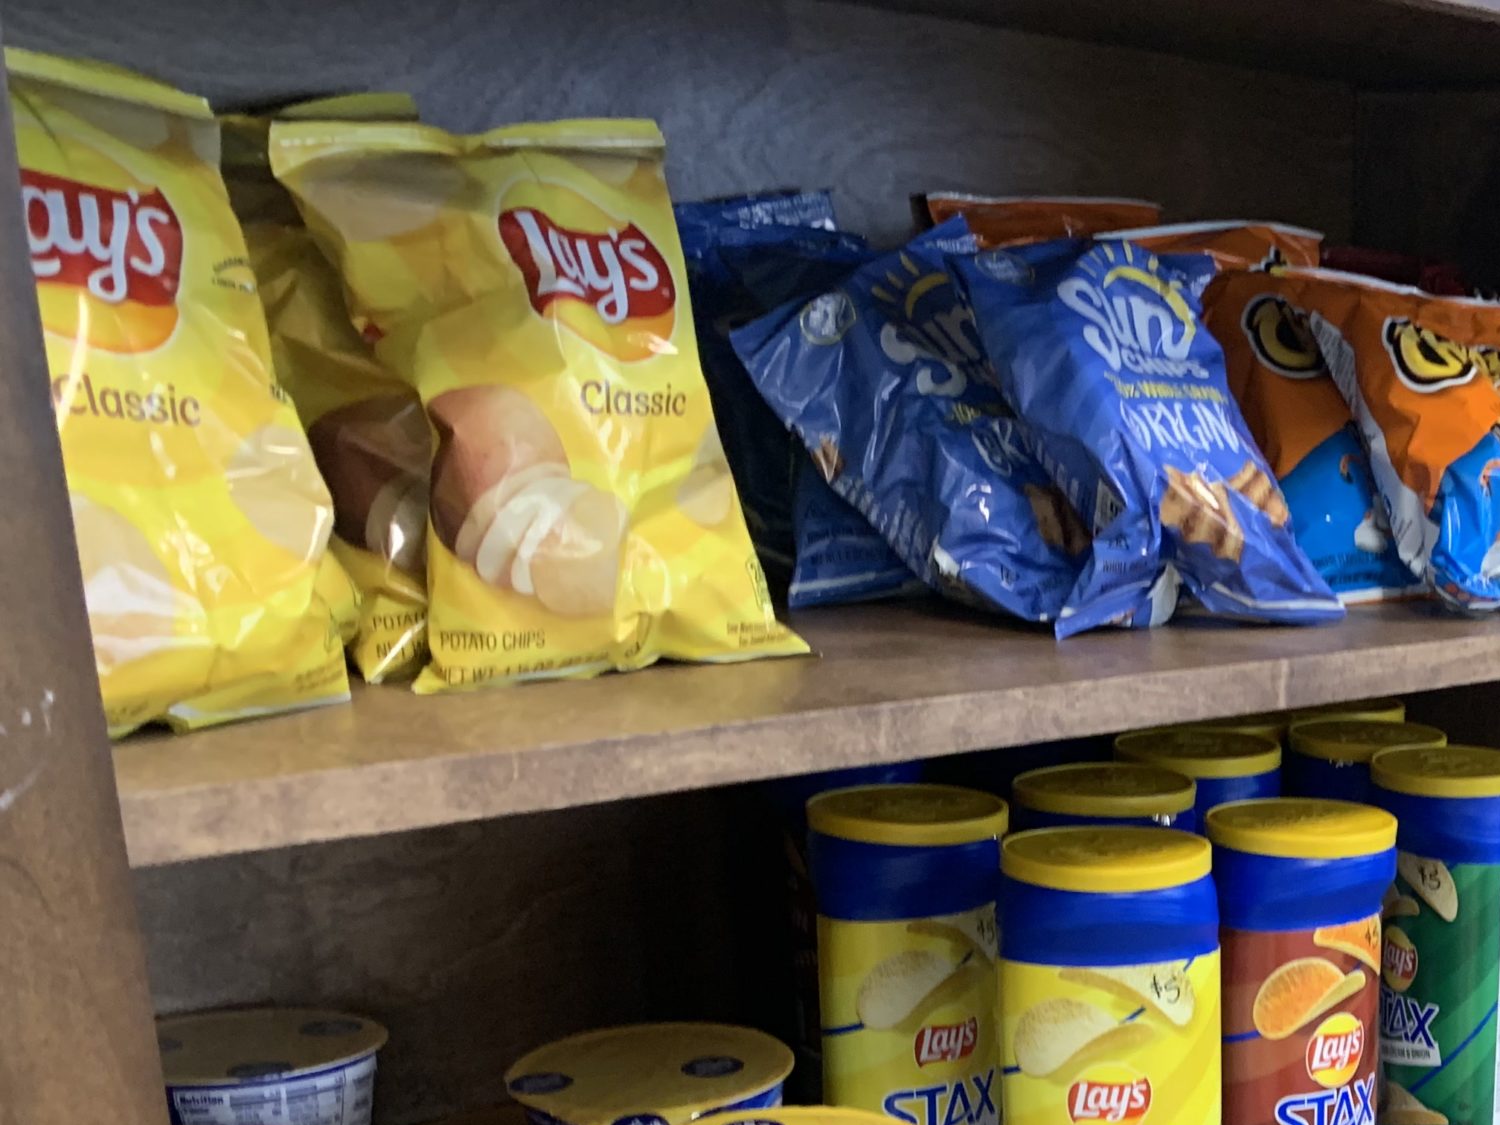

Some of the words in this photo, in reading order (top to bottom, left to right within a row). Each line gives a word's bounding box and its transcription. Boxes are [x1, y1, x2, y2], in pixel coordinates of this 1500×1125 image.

[22, 184, 170, 304] ay's
[512, 209, 660, 325] Lay's
[1056, 277, 1197, 372] Sun
[50, 372, 202, 427] Classic
[580, 376, 687, 418] Classic
[439, 631, 498, 652] POTATO
[501, 630, 547, 650] CHIPS
[919, 1017, 976, 1064] Lay's
[1381, 983, 1441, 1049] TAX
[1311, 1029, 1363, 1071] Lay's
[1073, 1079, 1148, 1122] Lay's
